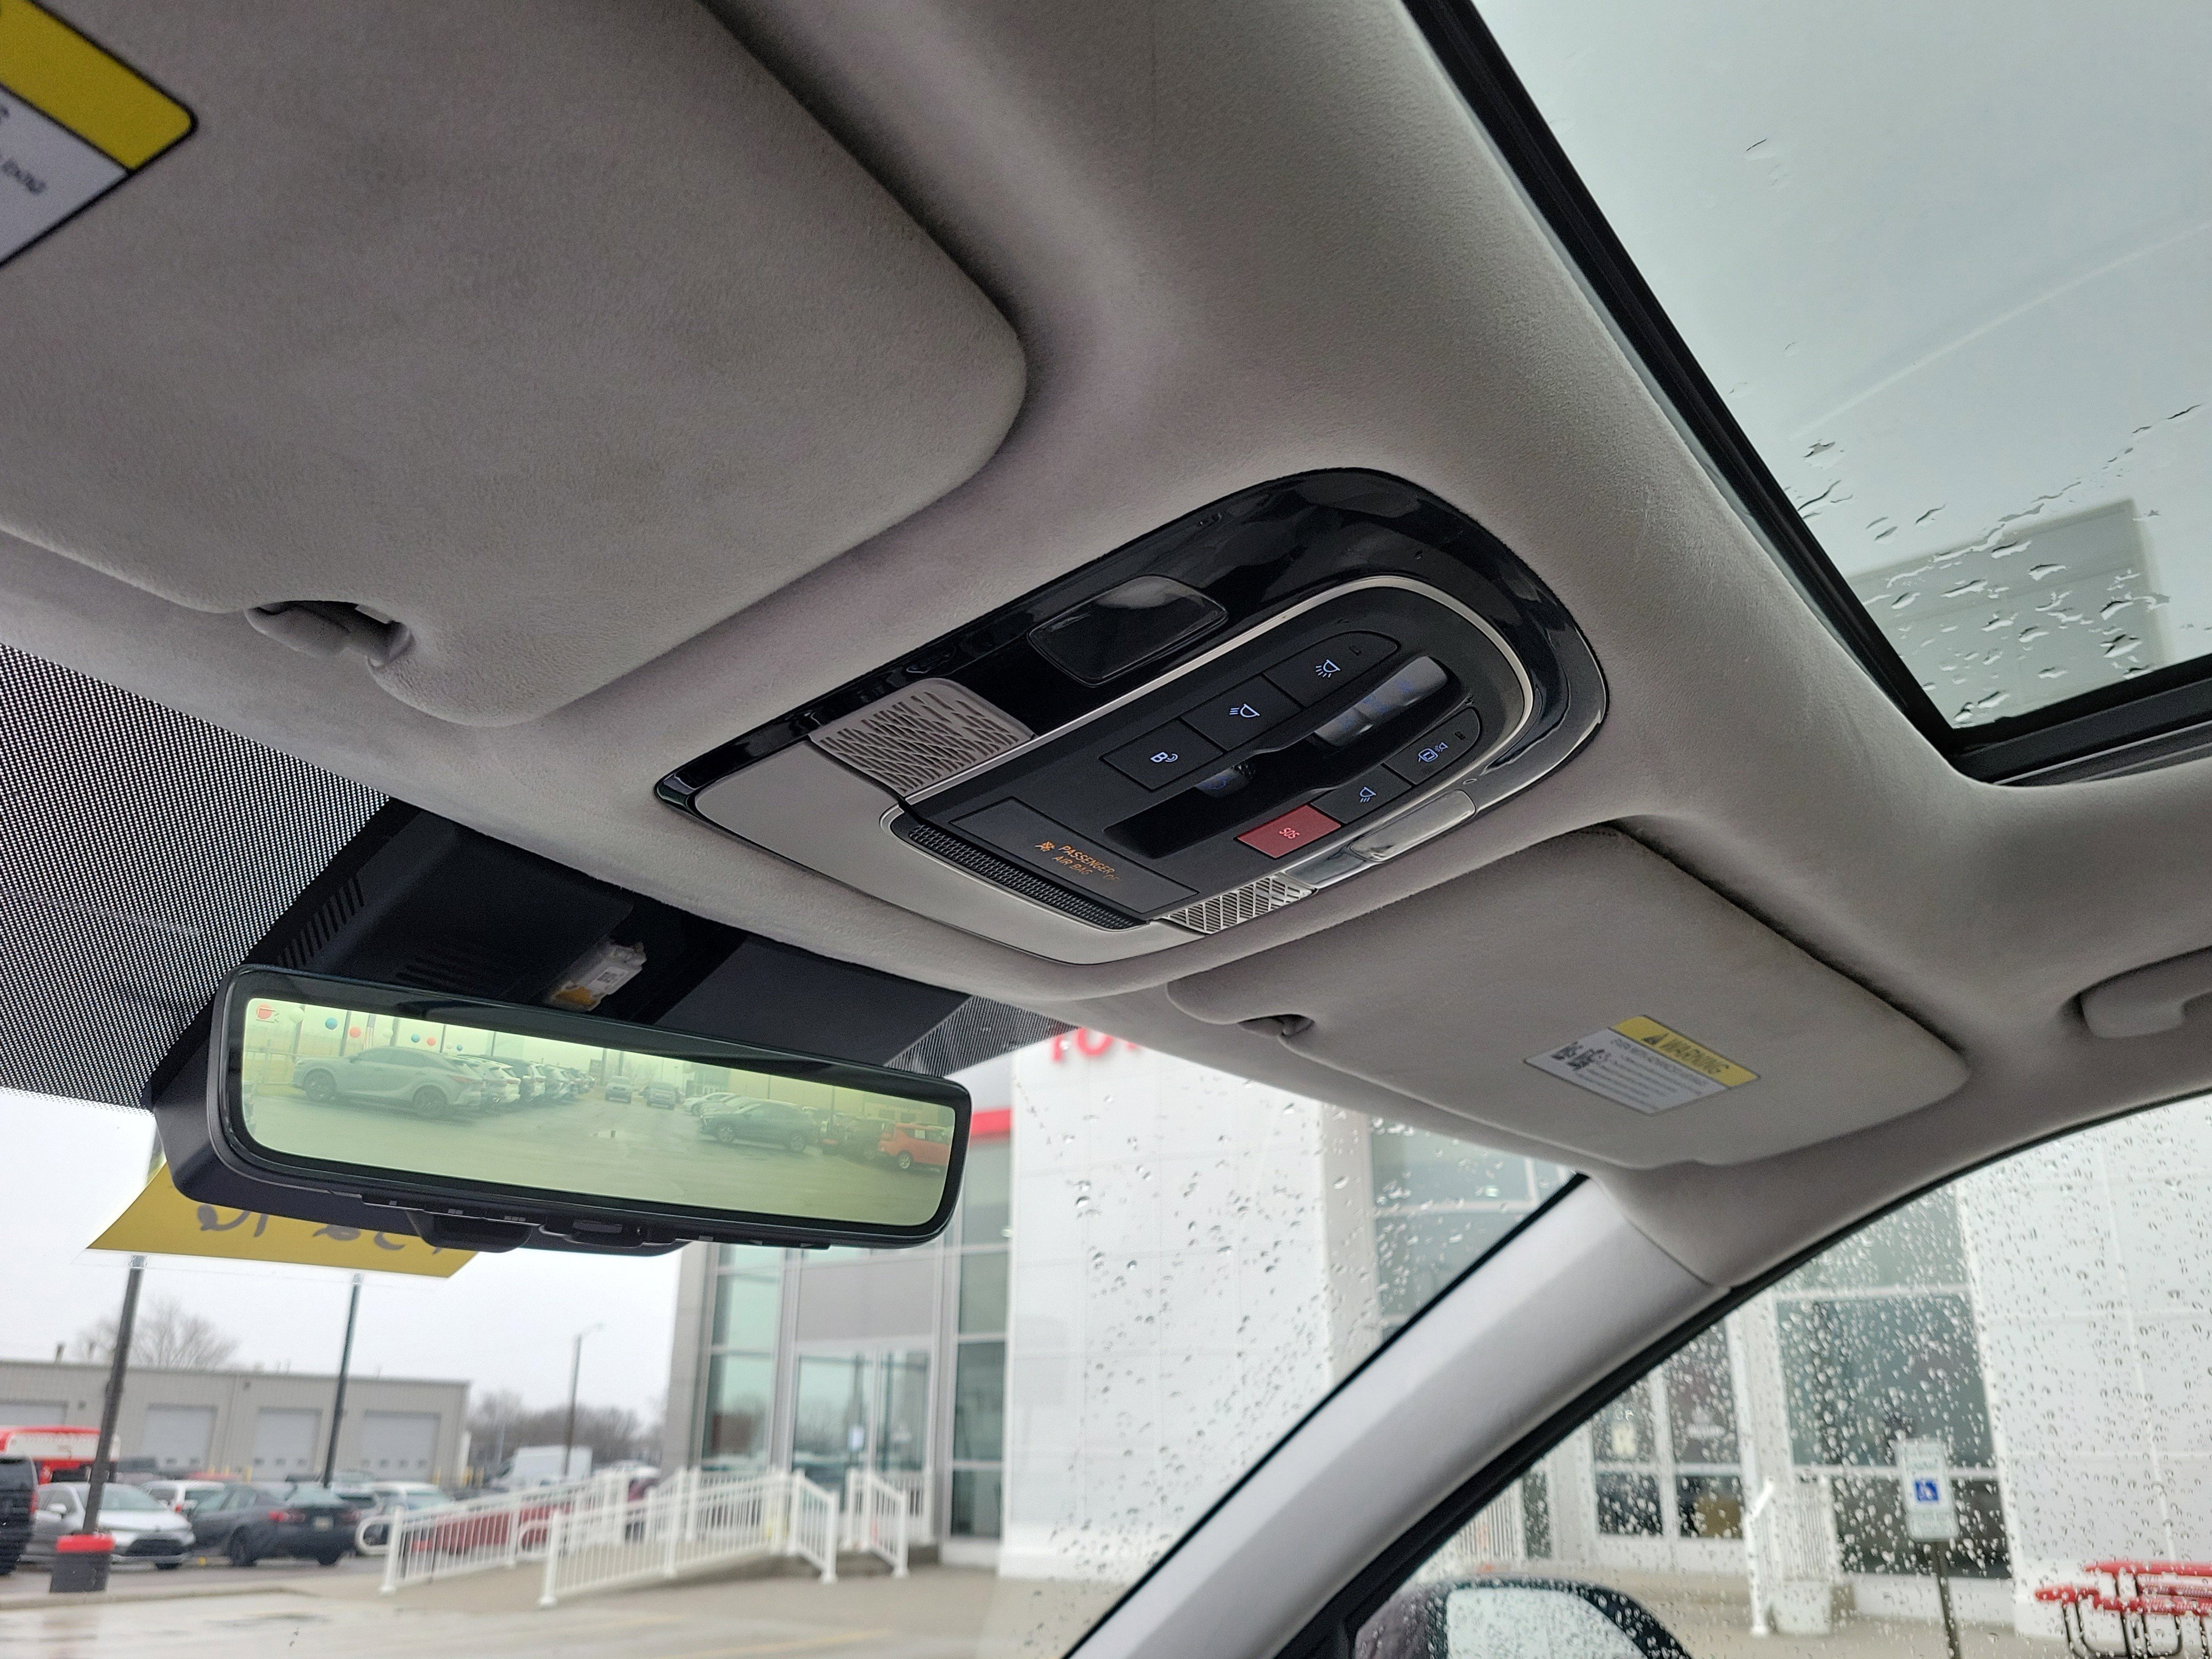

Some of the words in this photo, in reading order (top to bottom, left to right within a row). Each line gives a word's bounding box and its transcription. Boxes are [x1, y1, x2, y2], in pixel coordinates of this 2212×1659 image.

[1279, 828, 1300, 839] SOS
[1052, 856, 1073, 866] AIR
[1069, 864, 1093, 874] BAG
[1058, 845, 1115, 874] PASSENGER
